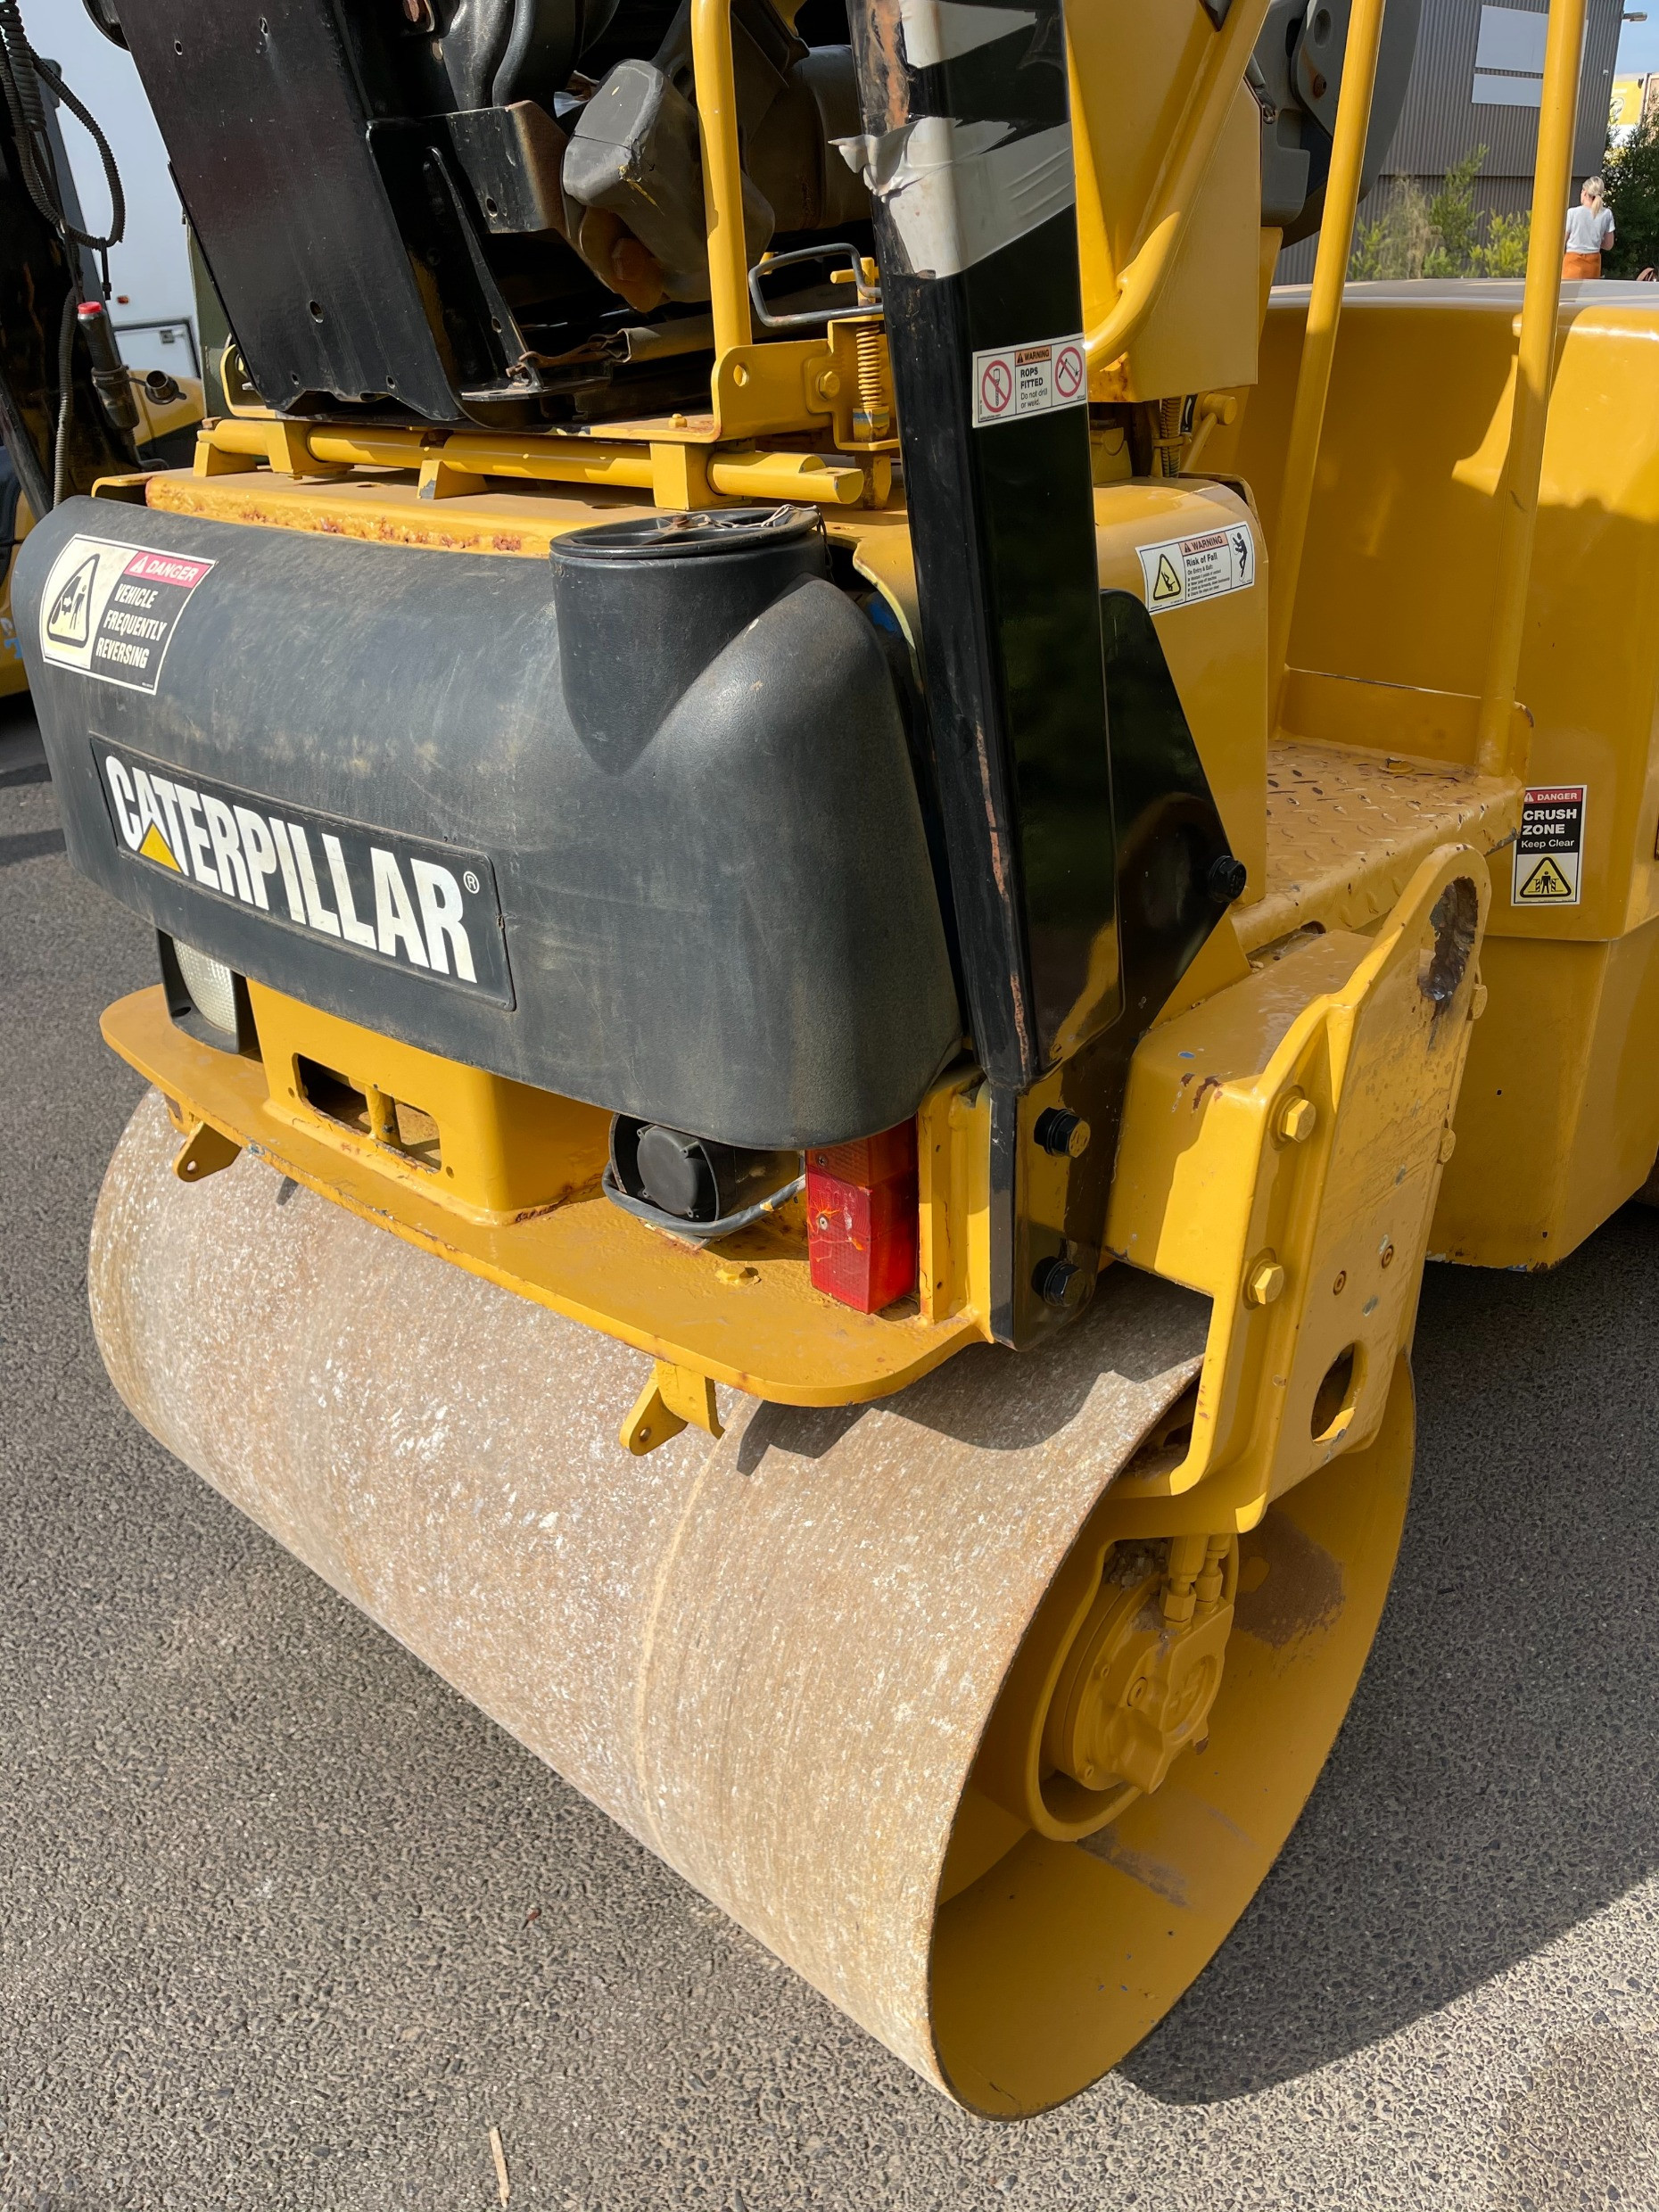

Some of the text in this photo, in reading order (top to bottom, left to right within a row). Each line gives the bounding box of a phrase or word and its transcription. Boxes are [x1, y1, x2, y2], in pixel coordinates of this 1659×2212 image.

[1024, 349, 1050, 361] WARNING
[1020, 367, 1038, 378] ROPS
[1020, 377, 1044, 390] FITTED
[1020, 387, 1048, 400] Do not drill
[1191, 535, 1223, 550] WARNING
[1186, 552, 1217, 567] Risk of Fall
[145, 560, 199, 582] DANGER
[114, 583, 159, 609] VEHICLE
[103, 610, 168, 641] FREQUENTLY
[95, 637, 150, 669] REVERSING
[1537, 792, 1578, 801] DANGER
[1523, 808, 1577, 821] CRUSH
[1522, 823, 1565, 836] ZONE
[1521, 838, 1575, 849] Keep Clear
